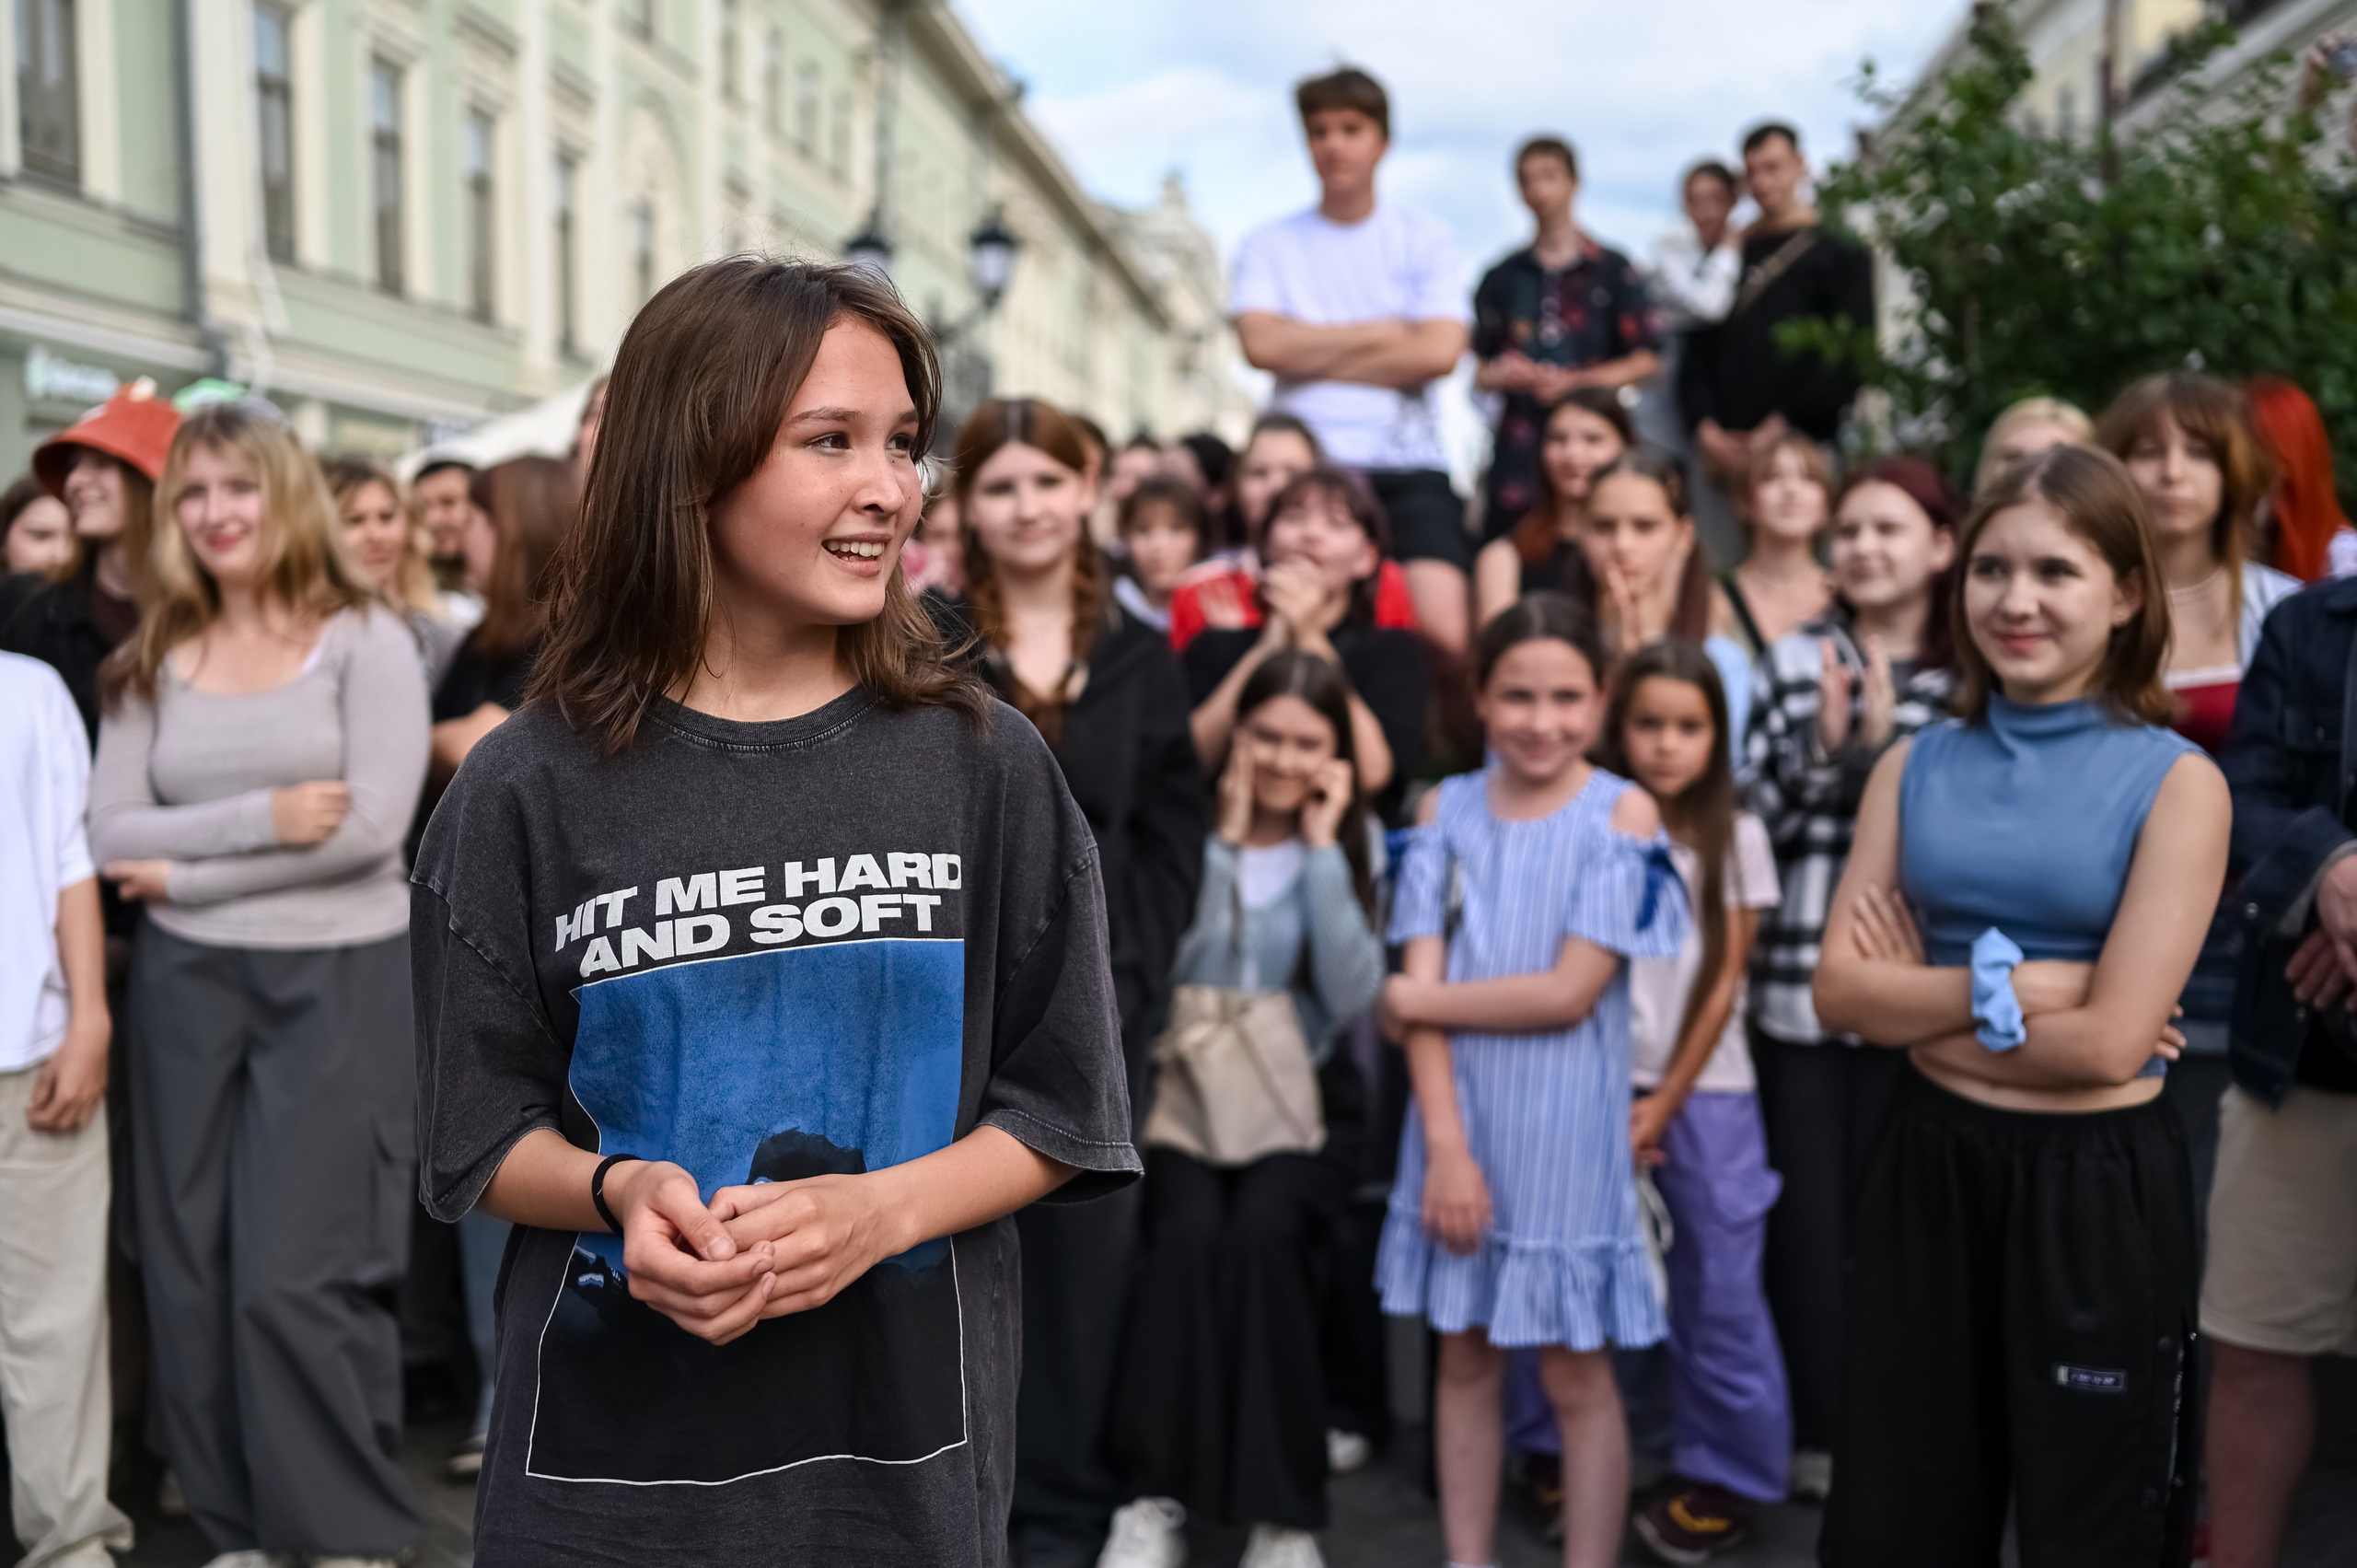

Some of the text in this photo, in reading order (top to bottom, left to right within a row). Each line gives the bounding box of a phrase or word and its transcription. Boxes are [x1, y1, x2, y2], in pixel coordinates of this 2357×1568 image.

[555, 852, 962, 952] HIT ME HARD
[579, 894, 942, 978] AND SOFT
